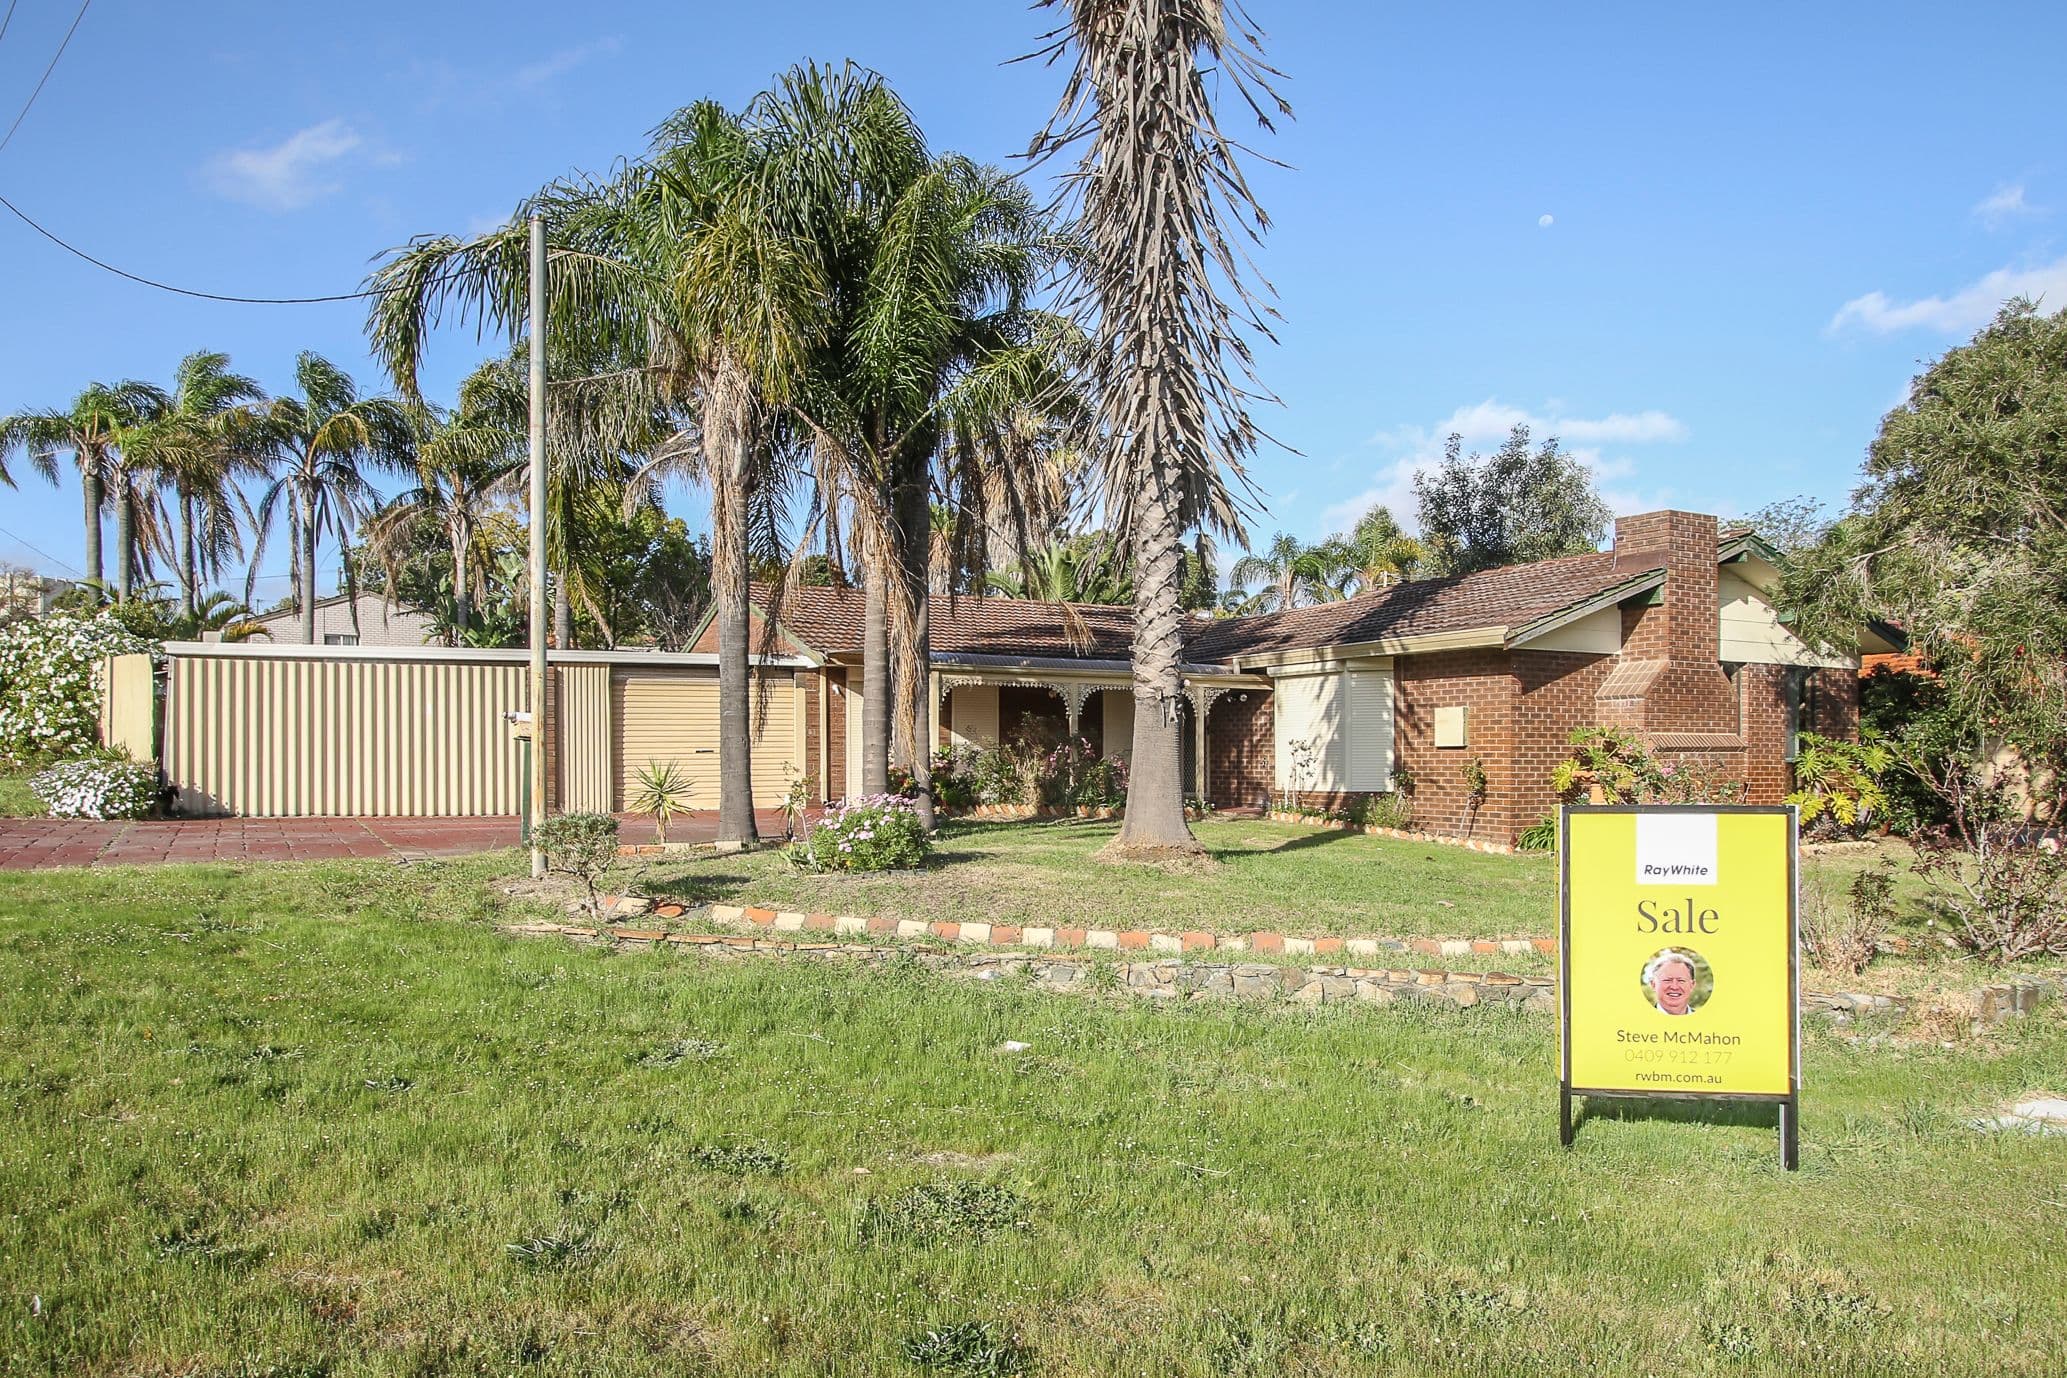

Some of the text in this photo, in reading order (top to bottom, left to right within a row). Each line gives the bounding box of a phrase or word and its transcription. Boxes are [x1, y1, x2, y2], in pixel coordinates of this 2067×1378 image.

[1637, 898, 1720, 934] Sale
[1616, 1029, 1741, 1045] Steve McMahon
[1624, 1048, 1733, 1065] 0409 912 177
[1635, 1071, 1722, 1084] rwbm.com.au
